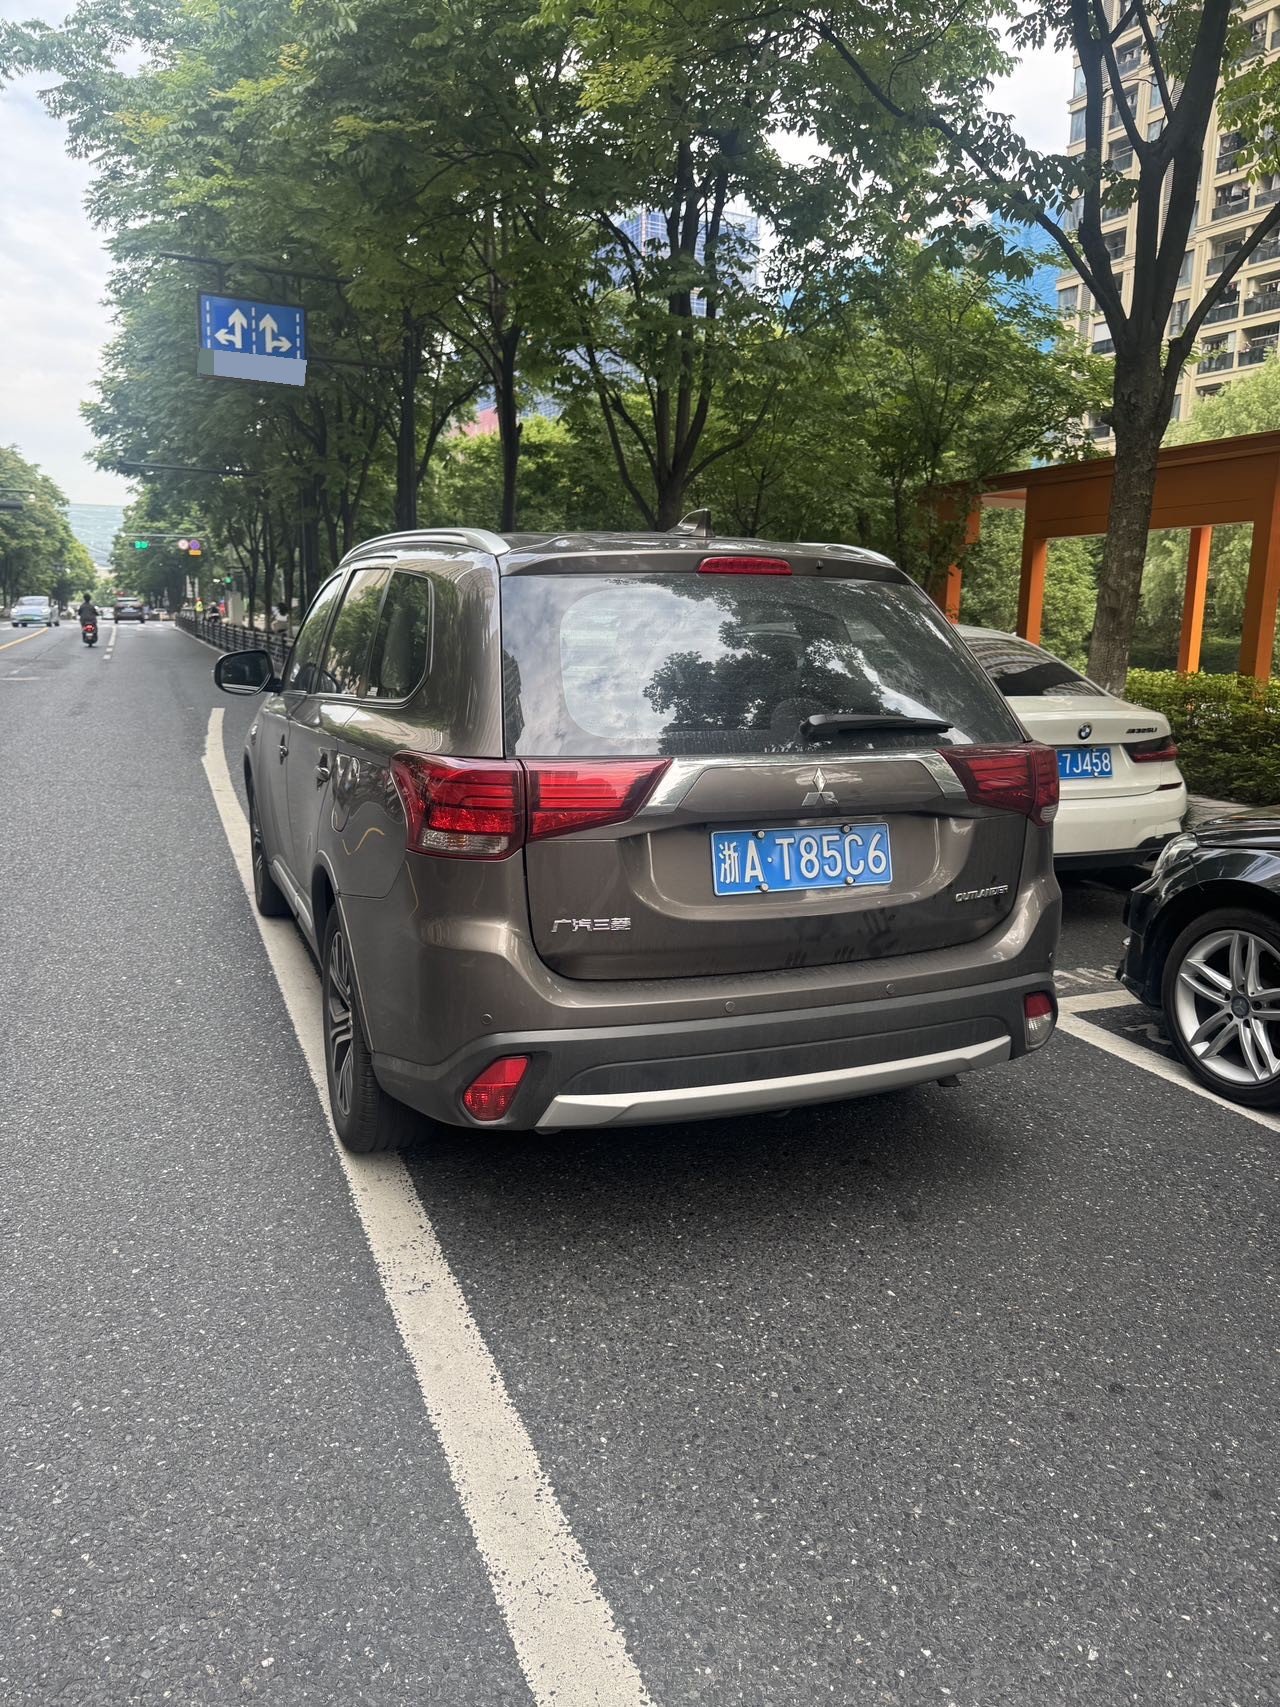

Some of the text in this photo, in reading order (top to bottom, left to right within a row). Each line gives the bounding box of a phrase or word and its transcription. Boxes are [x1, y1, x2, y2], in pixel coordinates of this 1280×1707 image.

[719, 833, 887, 884] 浙A·T85C6
[551, 917, 631, 933] 广汽三菱
